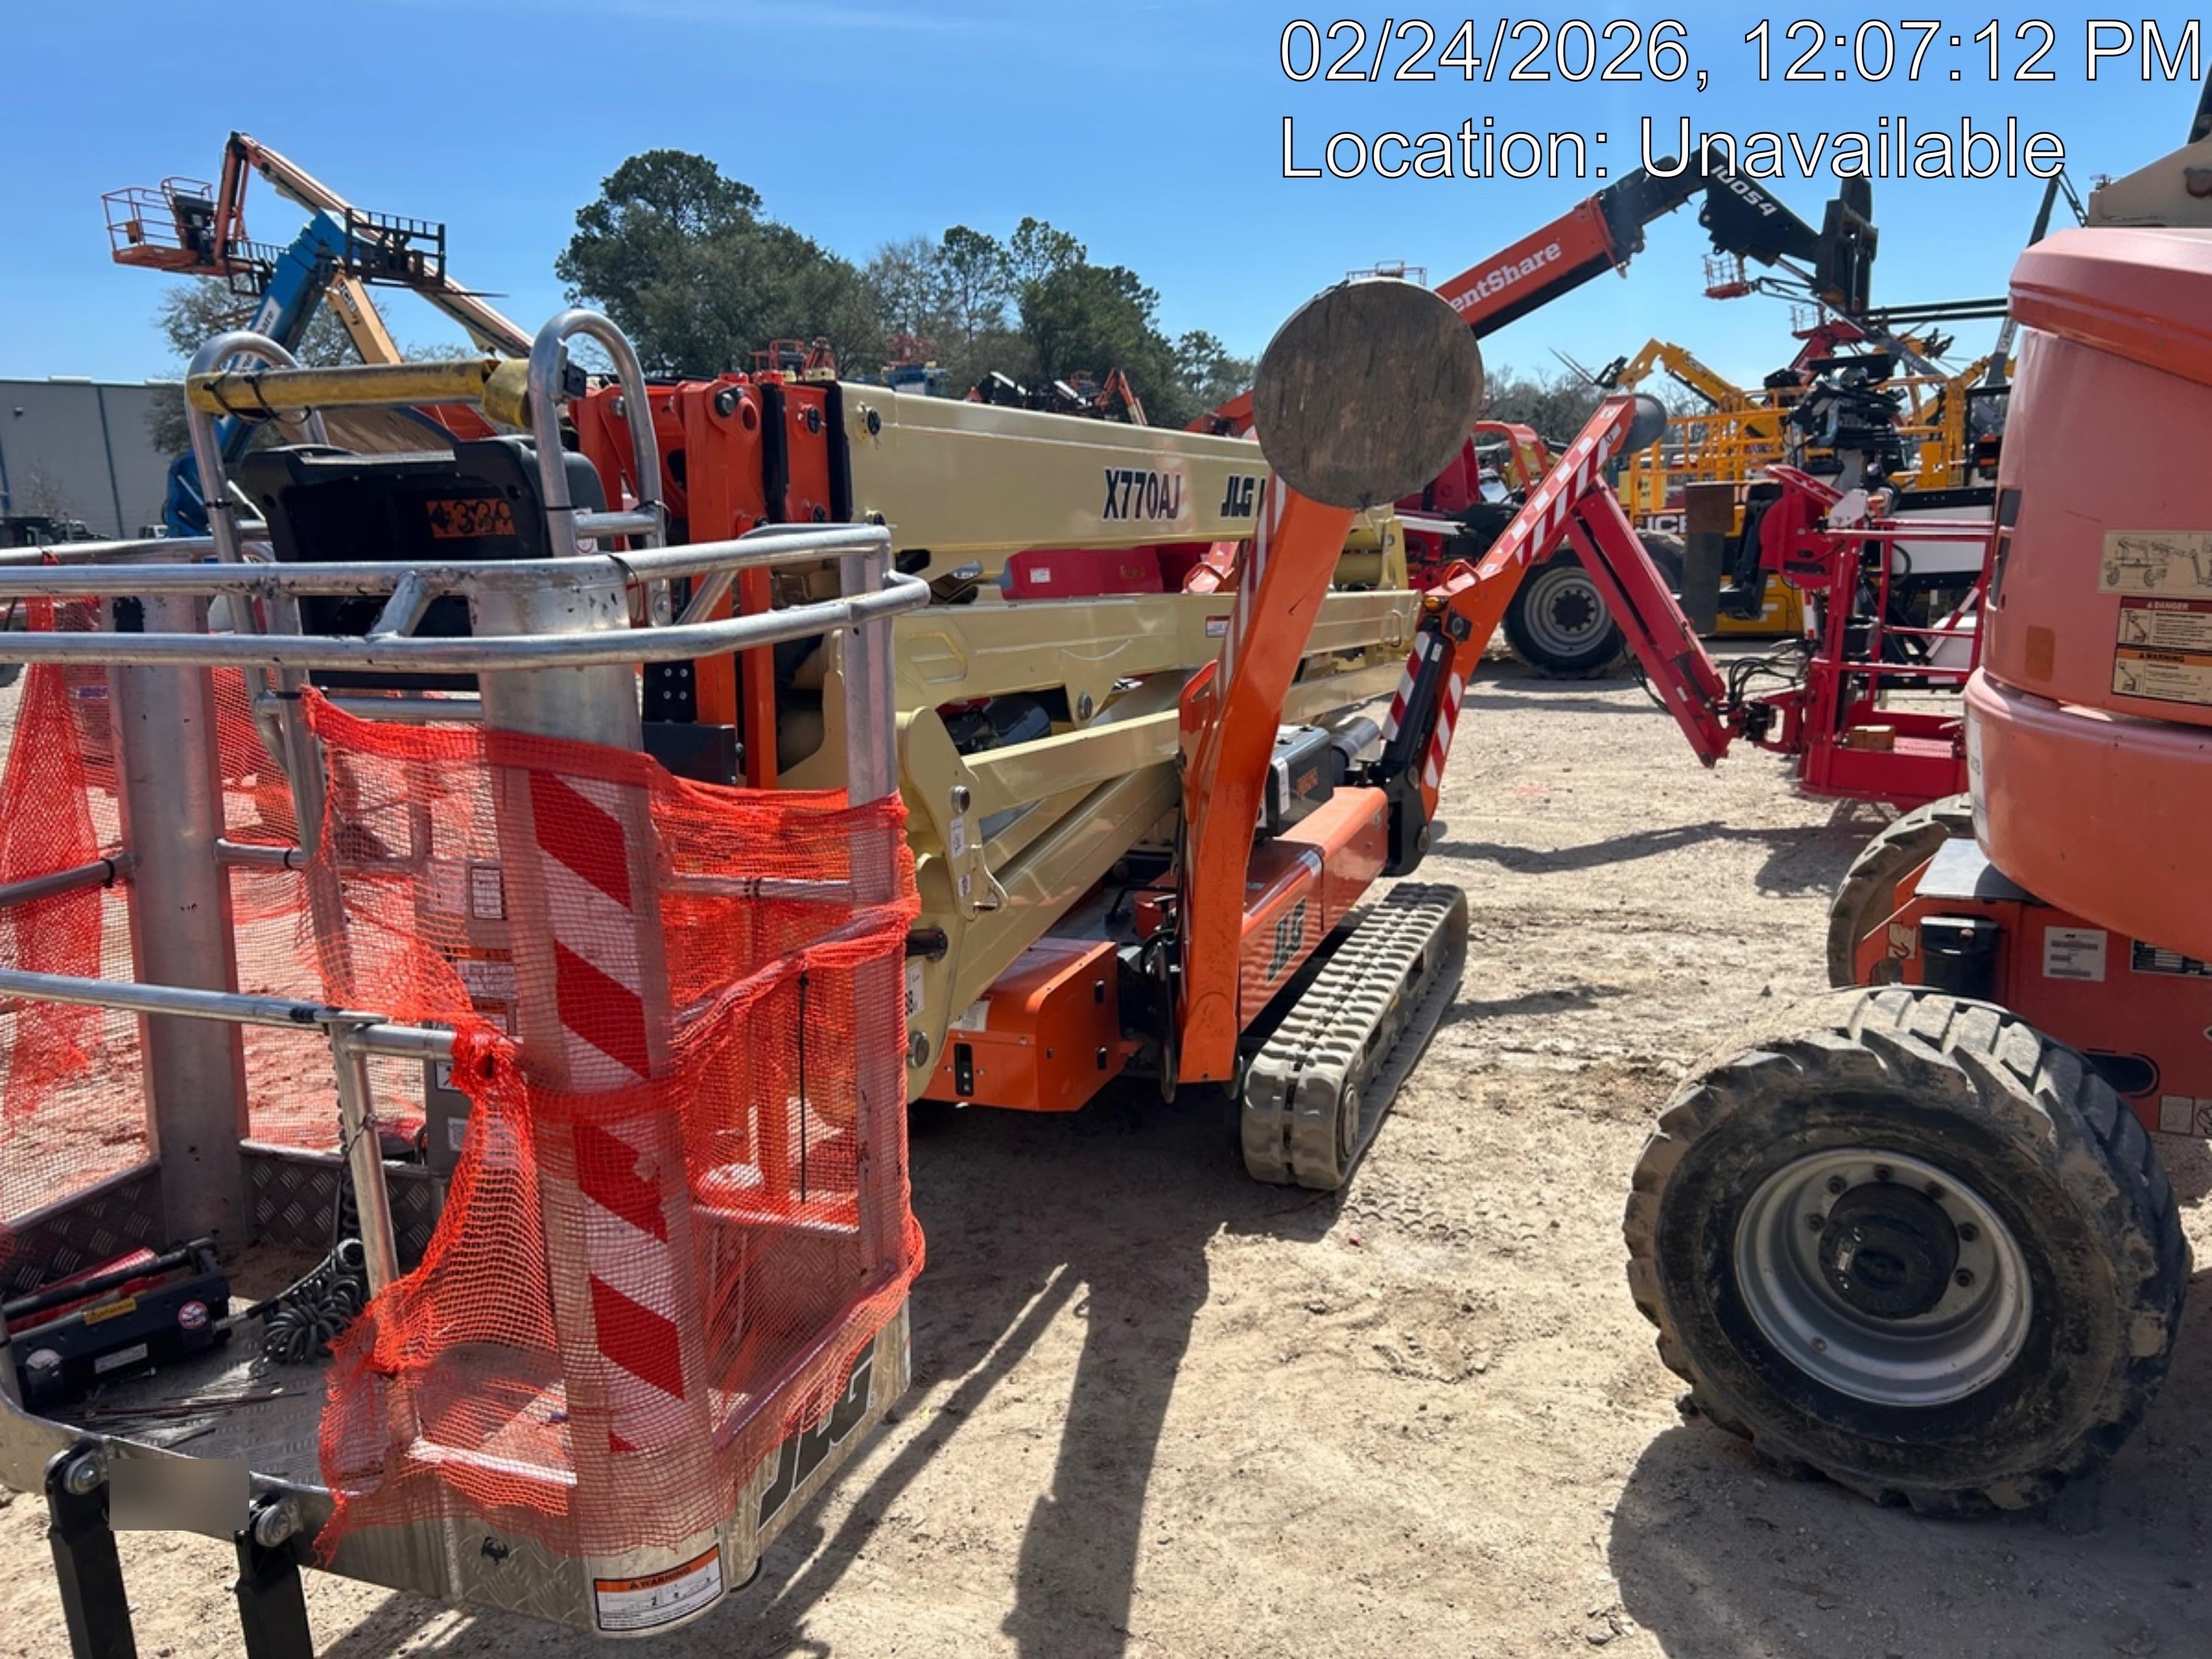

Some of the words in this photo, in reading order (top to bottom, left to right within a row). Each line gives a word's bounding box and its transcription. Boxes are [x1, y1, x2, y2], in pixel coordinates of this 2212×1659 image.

[1449, 241, 1563, 312] entShare
[1103, 469, 1180, 519] X770AJ
[1220, 475, 1255, 517] JLG
